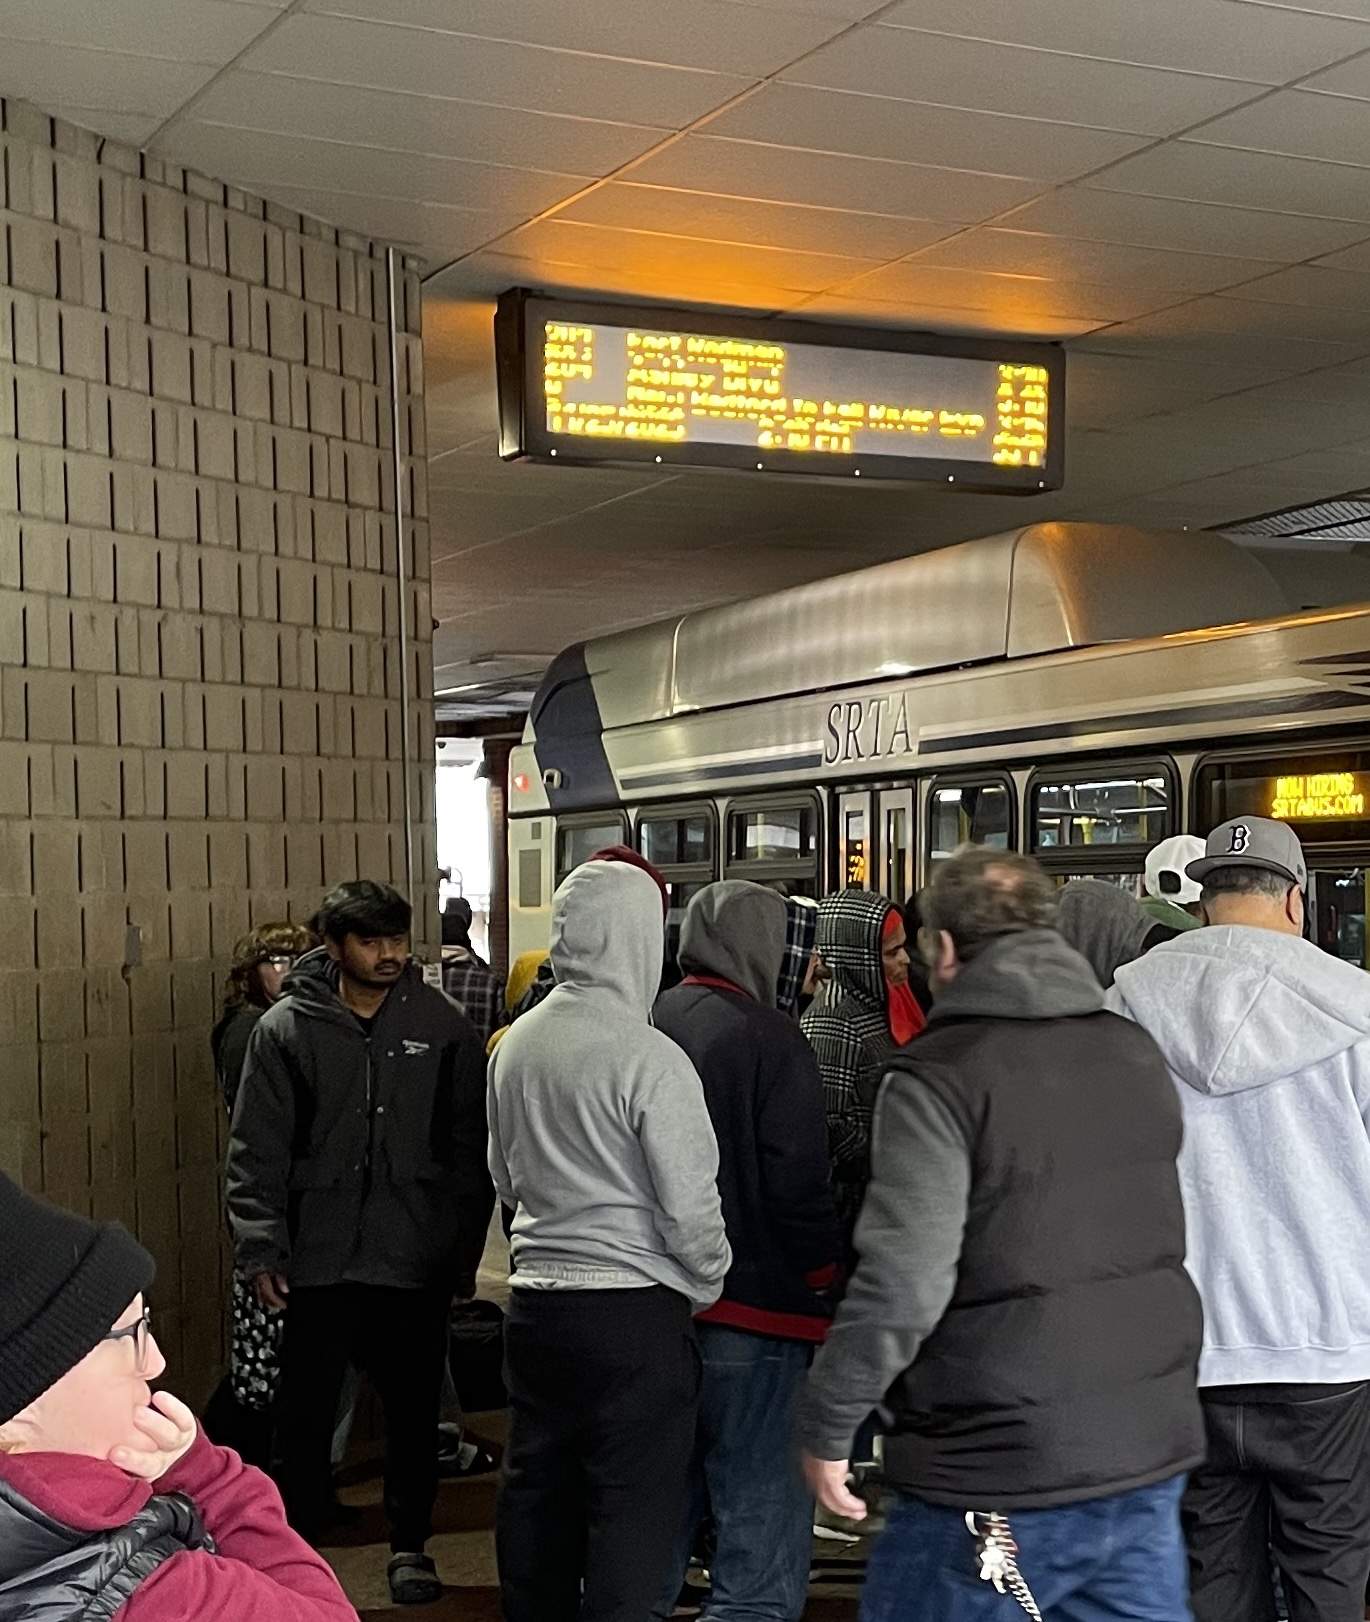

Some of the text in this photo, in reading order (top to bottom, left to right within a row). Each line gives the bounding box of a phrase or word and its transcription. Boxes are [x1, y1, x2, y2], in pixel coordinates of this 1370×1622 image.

[825, 690, 915, 767] SRTA
[1277, 773, 1354, 799] NOW HIRING
[1271, 794, 1364, 819] SRTABUS.COM
[1225, 824, 1251, 855] B
